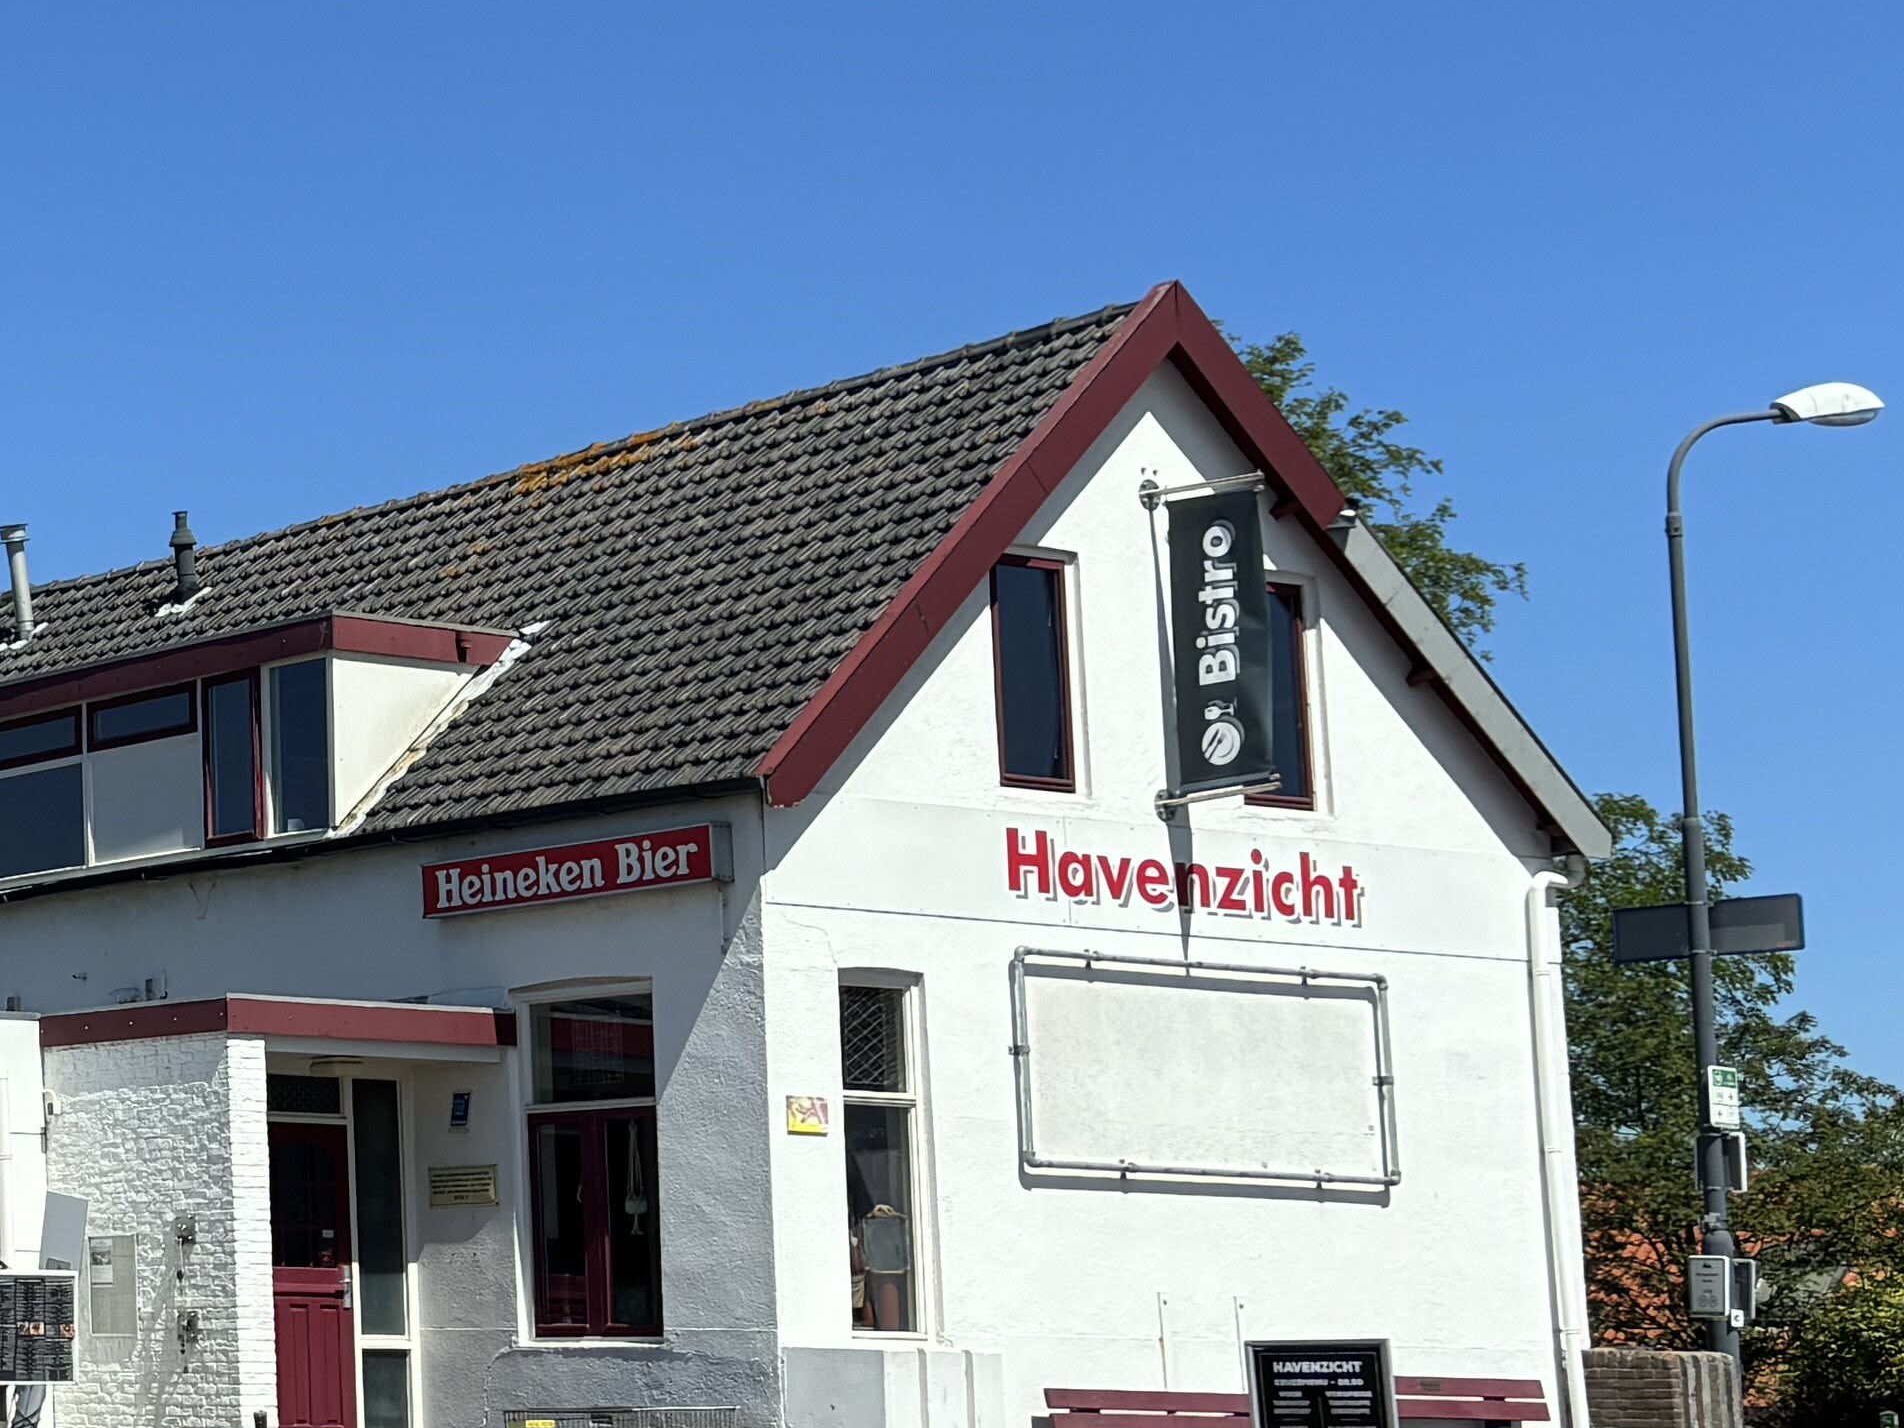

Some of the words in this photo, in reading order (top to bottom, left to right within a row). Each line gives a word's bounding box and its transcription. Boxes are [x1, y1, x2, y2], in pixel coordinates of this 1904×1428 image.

[1195, 525, 1236, 687] Bistro
[435, 855, 606, 910] Heineken
[614, 839, 698, 885] Bier
[1005, 826, 1359, 922] Havenzicht
[1272, 1361, 1363, 1374] HAVENZICHT
